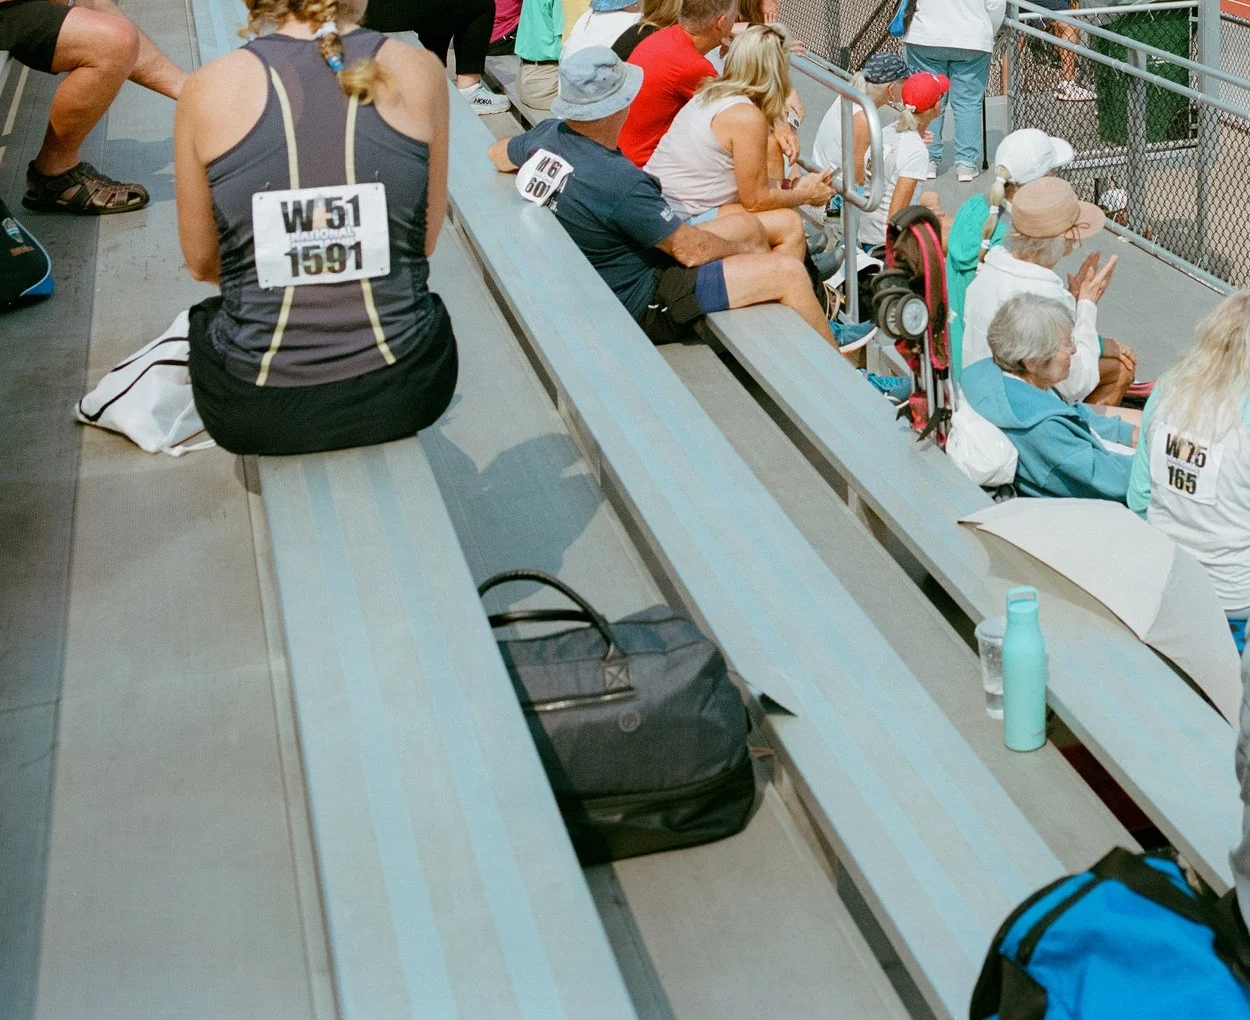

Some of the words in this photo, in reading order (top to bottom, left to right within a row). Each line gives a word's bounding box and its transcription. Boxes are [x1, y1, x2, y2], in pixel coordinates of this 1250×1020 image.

[280, 198, 315, 234] W
[324, 194, 362, 230] 51
[284, 241, 363, 278] 1591
[1166, 432, 1181, 459] W
[1186, 440, 1208, 468] 75
[1168, 465, 1198, 495] 165
